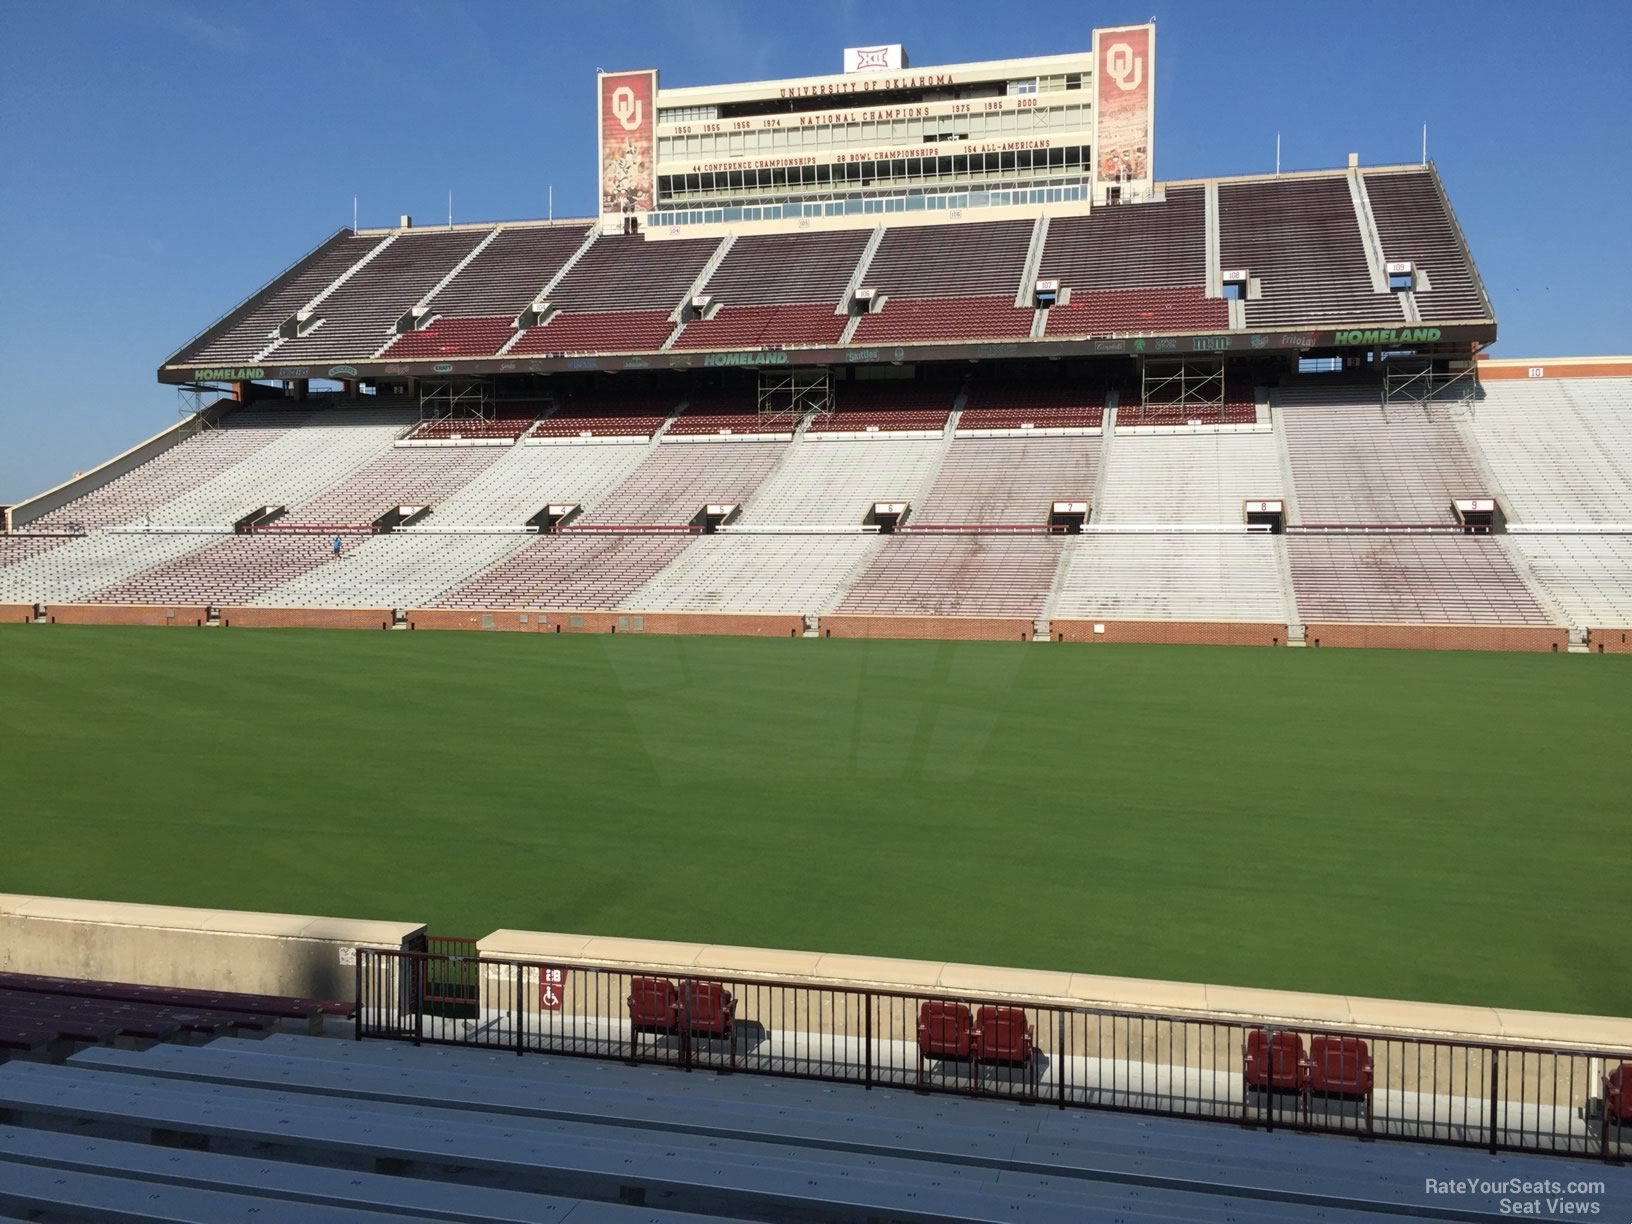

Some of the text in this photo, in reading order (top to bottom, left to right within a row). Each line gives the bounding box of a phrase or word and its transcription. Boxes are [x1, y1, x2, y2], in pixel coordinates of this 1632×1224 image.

[1106, 42, 1143, 91] OU
[780, 75, 954, 98] UNIVERSITY OF OKLAHOMA
[612, 86, 642, 131] OU
[674, 98, 1038, 134] 1950 1955 1956 1974 NATIONAL CHAMPIONS 1975 1985 2000
[964, 140, 1050, 153] 154 ALL-AMERICANS
[850, 152, 872, 161] BOWL
[874, 148, 939, 160] CHAMPIONSHIPS
[692, 157, 817, 173] 44 CONFERENCE CHAMPIONSHIPS
[1393, 263, 1405, 271] 109
[1229, 271, 1240, 279] 108
[1334, 328, 1441, 345] HOMELAND
[704, 351, 788, 366] HOMELAND
[195, 368, 265, 380] HOMELAND
[1531, 368, 1541, 377] 10
[560, 506, 566, 514] 4
[719, 505, 725, 514] 5
[888, 503, 893, 512] 6
[1067, 503, 1073, 511] 7
[1261, 502, 1267, 511] 8
[1471, 501, 1478, 510] 9
